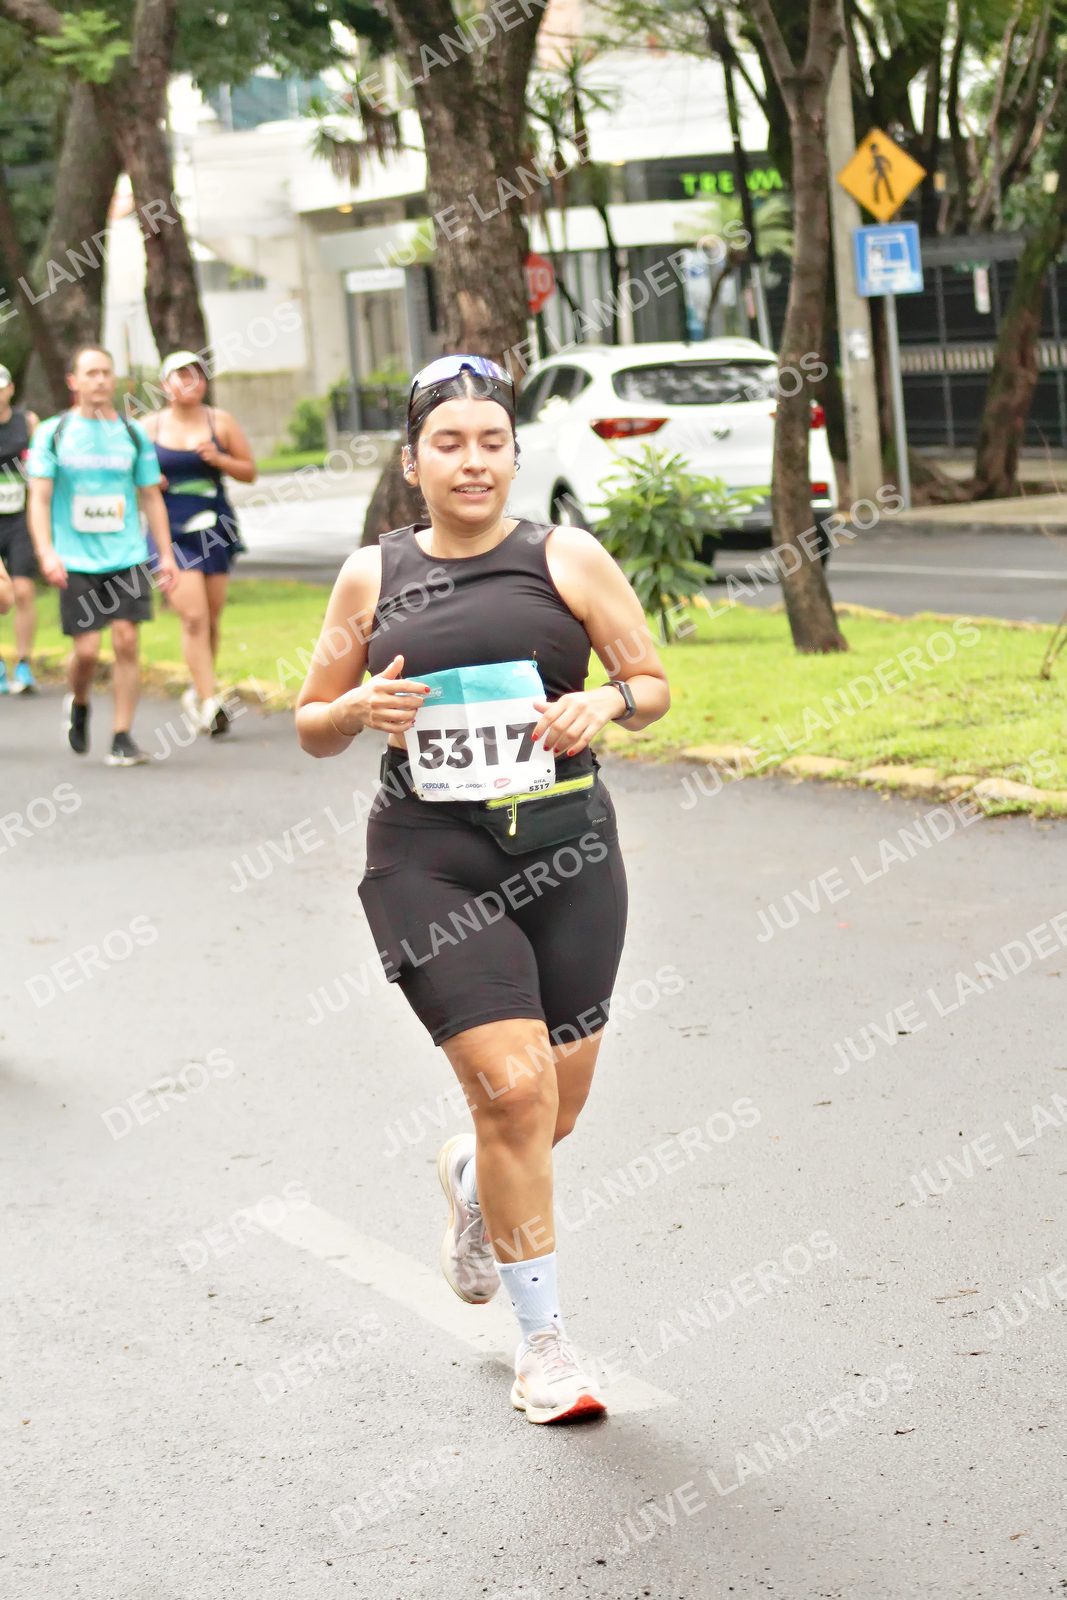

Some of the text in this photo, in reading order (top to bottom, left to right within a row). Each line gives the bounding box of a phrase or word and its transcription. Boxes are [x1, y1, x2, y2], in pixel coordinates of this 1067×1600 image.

[523, 266, 551, 293] TO
[417, 722, 538, 770] 5317
[529, 783, 551, 792] 5317
